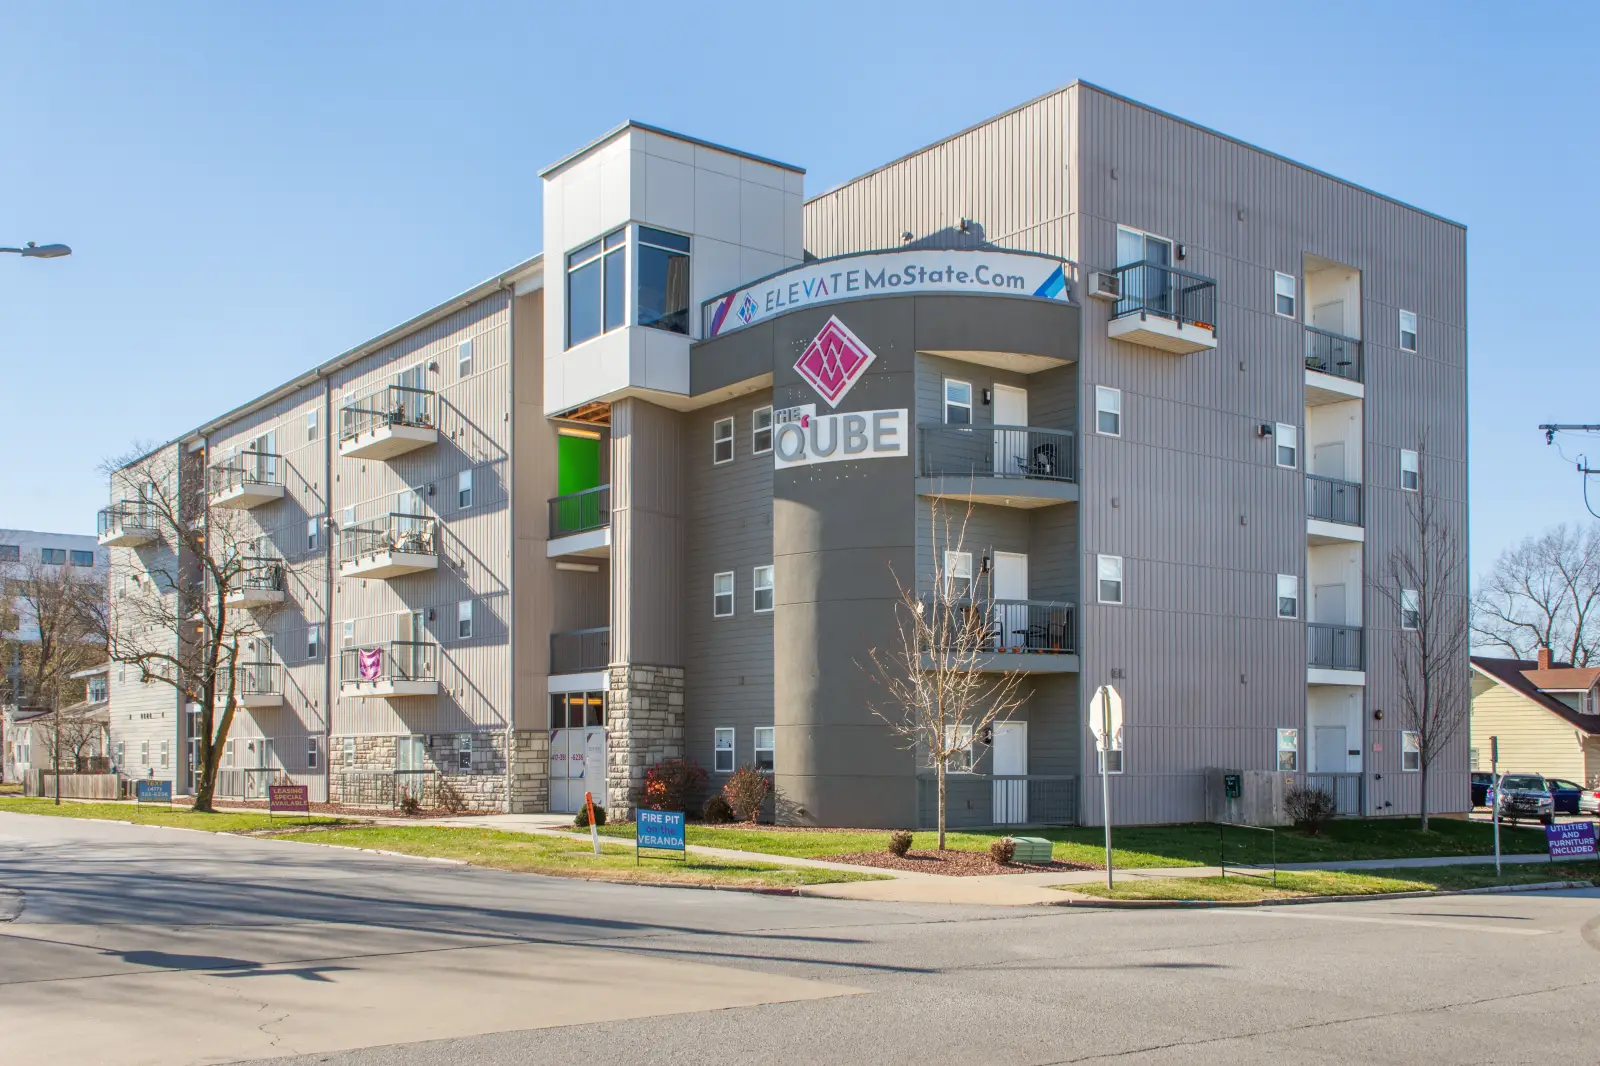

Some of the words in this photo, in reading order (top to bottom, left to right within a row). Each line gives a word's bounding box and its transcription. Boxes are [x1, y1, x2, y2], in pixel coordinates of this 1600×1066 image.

[775, 407, 801, 424] THE
[641, 813, 663, 823] FIRE
[665, 815, 680, 825] PIT
[660, 825, 676, 835] the
[1550, 823, 1588, 832] UTILITIES
[1562, 831, 1580, 839] AND
[638, 835, 684, 846] VERANDA
[1549, 838, 1595, 847] FURNITURE
[1552, 846, 1593, 854] INCLUDED
